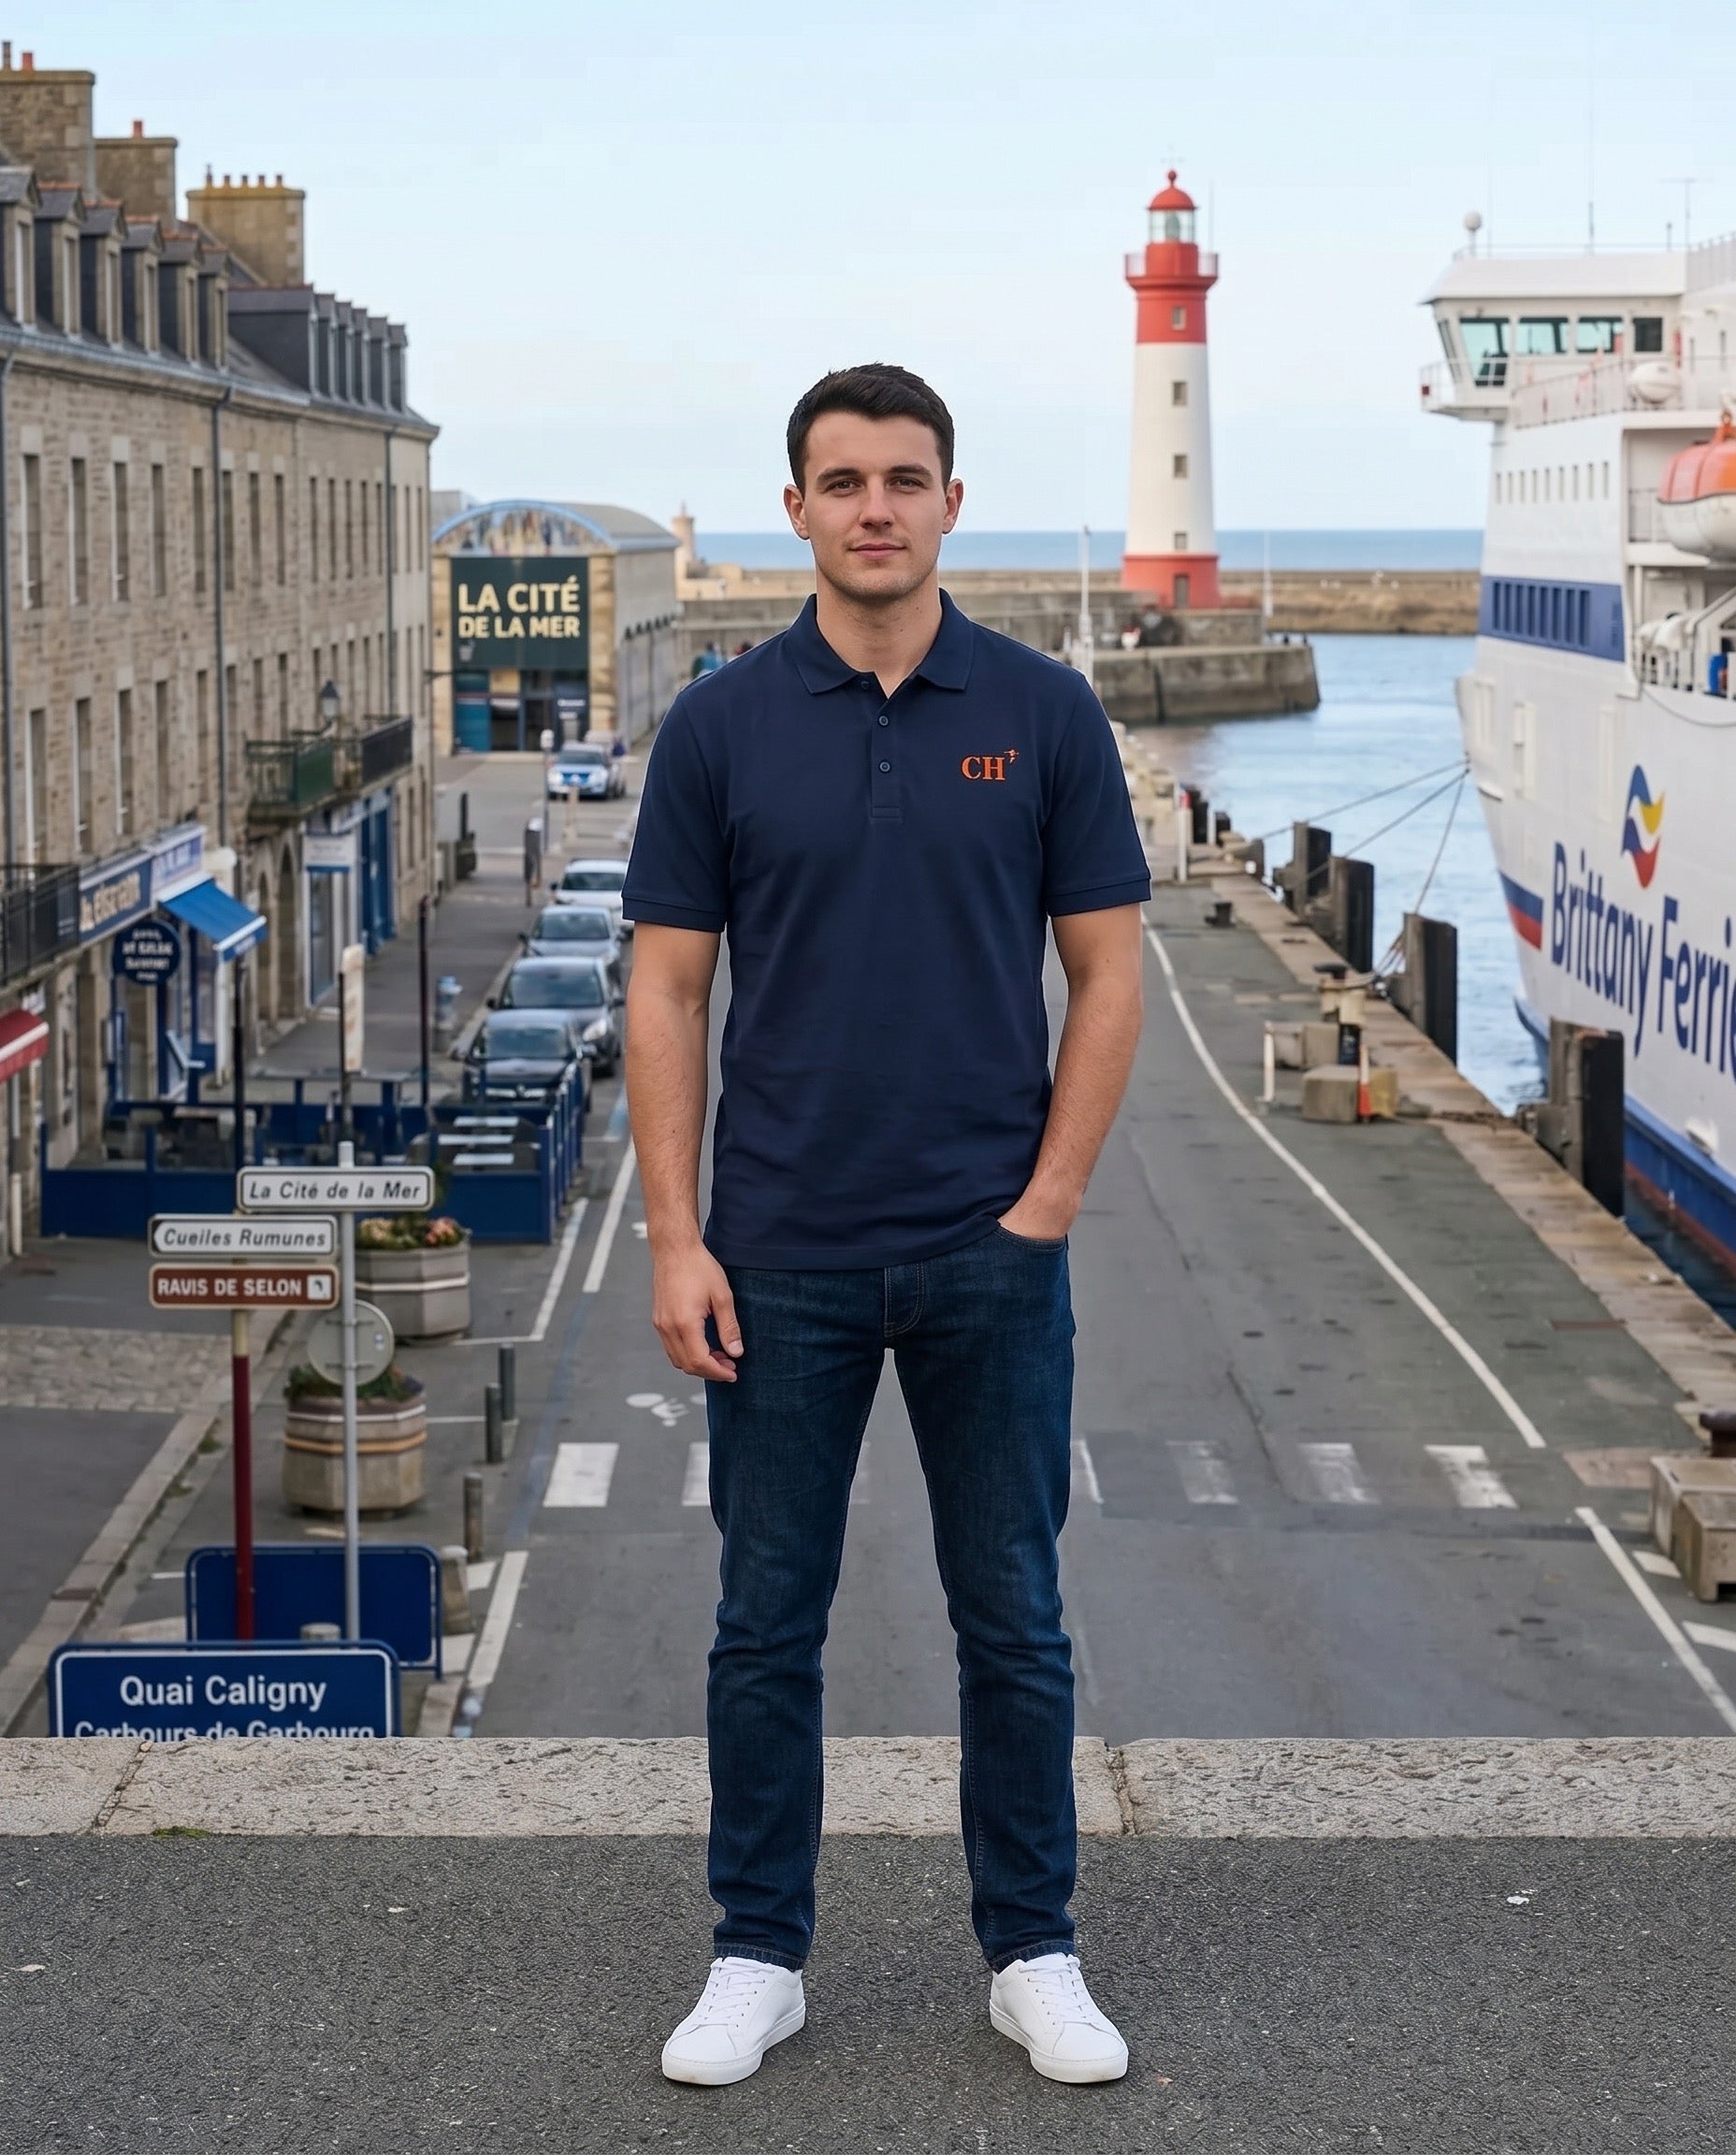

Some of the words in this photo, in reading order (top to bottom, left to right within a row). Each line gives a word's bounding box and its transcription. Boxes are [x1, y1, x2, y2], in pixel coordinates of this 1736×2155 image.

[458, 583, 500, 614] LA
[507, 574, 581, 614] CITÉ
[458, 615, 489, 639] DE
[494, 615, 526, 639] LA
[529, 615, 581, 639] MER
[961, 755, 1005, 782] CH
[1551, 841, 1653, 1059] Brittany
[250, 1181, 271, 1199] La
[280, 1180, 318, 1199] Cité
[326, 1181, 349, 1199] de
[357, 1181, 374, 1199] la
[383, 1181, 420, 1199] Mer
[239, 1228, 326, 1246] Rumunes
[157, 1278, 209, 1296] RAVIS
[214, 1278, 238, 1296] DE
[243, 1278, 302, 1297] SELON
[120, 1674, 194, 1706] Quai
[205, 1674, 327, 1714] Caligny
[206, 1721, 239, 1740] de
